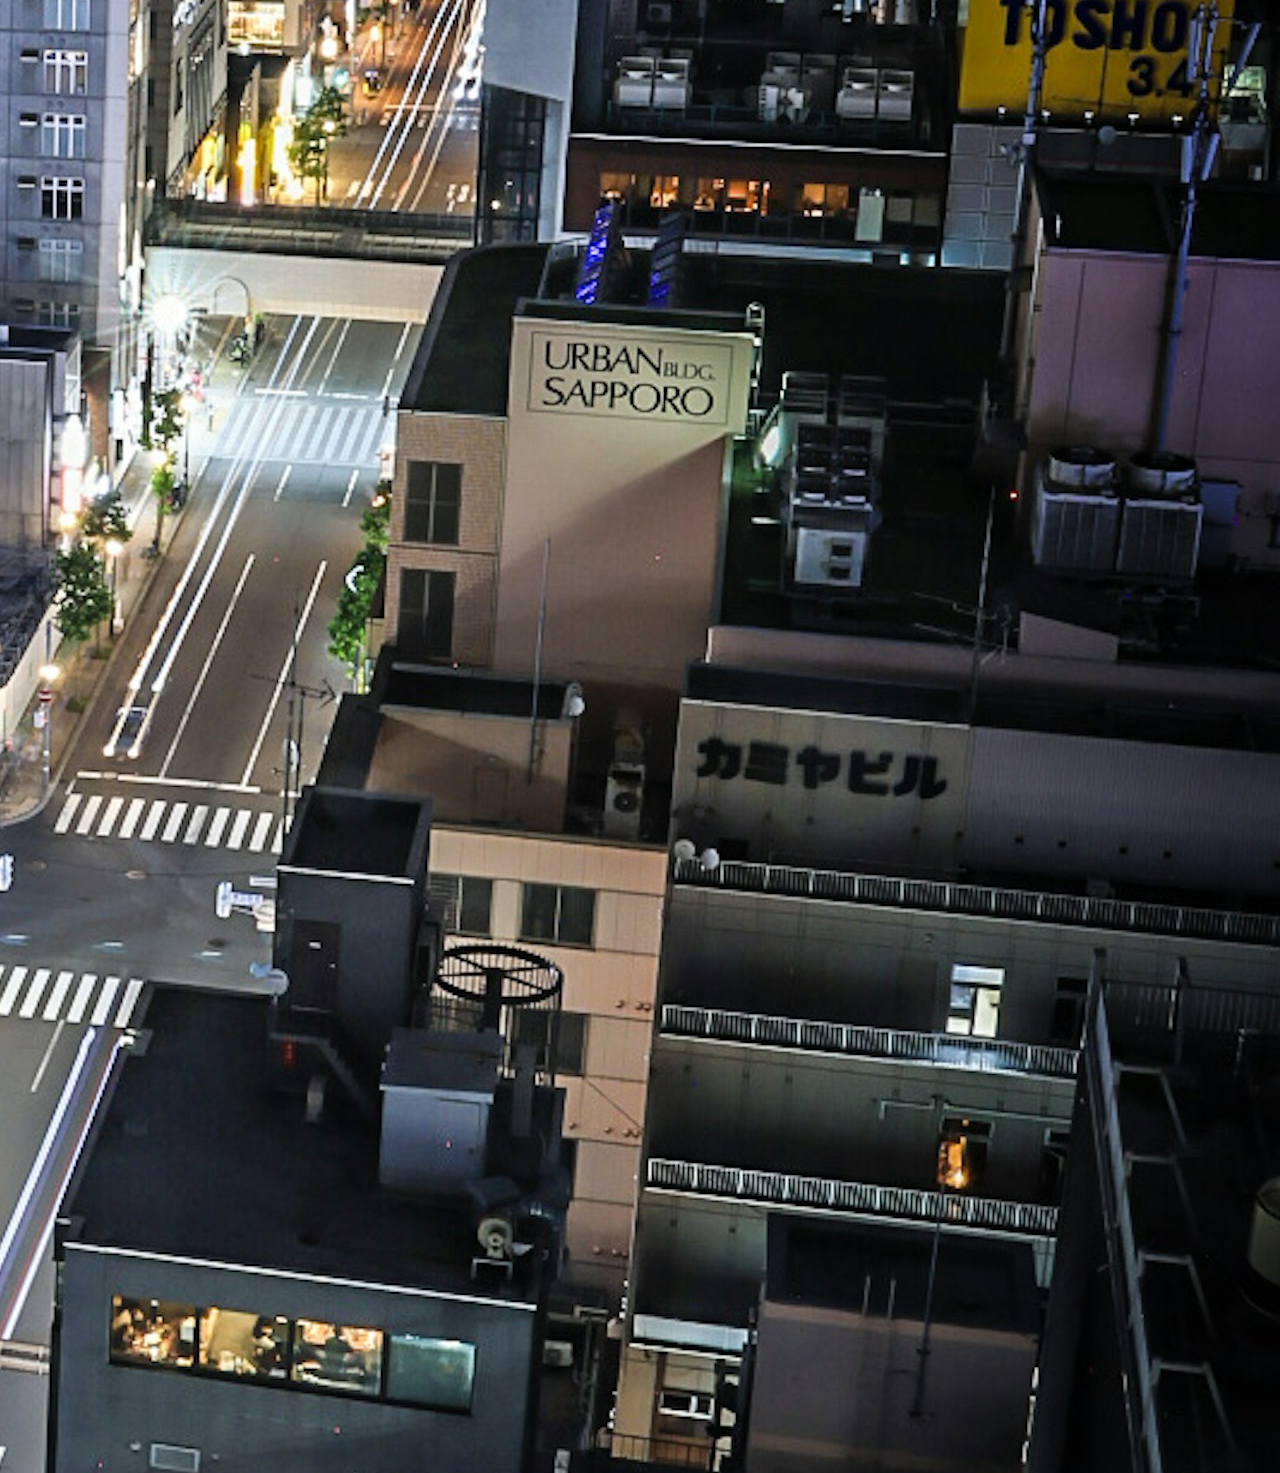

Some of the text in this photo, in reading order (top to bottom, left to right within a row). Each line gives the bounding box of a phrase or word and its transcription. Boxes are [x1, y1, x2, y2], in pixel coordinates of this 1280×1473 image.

[545, 340, 716, 382] URBAN BLDG.
[542, 376, 714, 416] SAPPORO
[696, 736, 948, 800] カミヤビル
